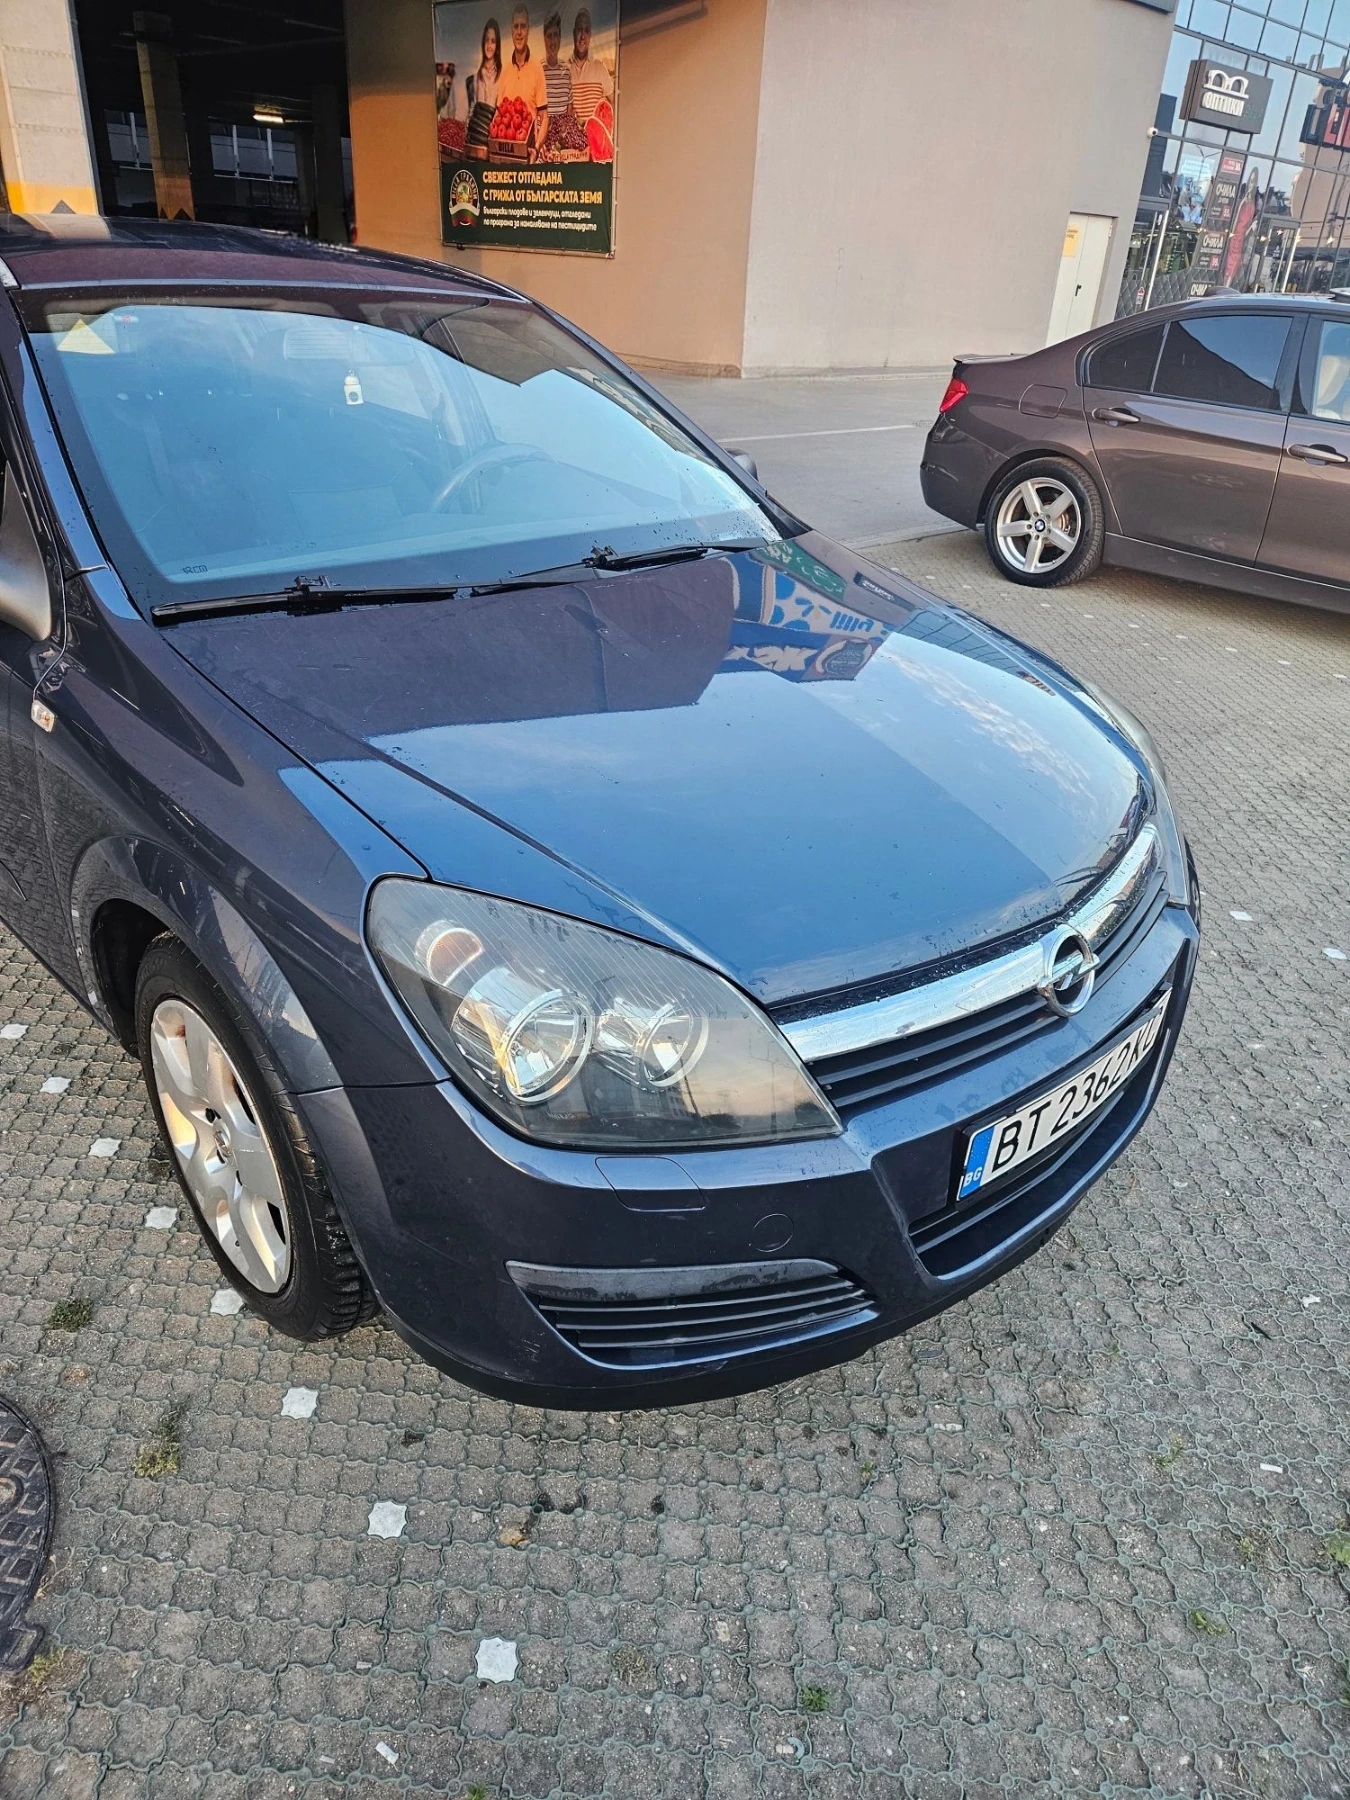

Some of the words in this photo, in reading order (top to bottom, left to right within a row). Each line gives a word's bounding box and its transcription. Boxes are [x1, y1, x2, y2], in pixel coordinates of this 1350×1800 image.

[482, 171, 517, 184] СВЕЖЕСТ
[517, 171, 563, 186] ОТГЛЕДАНА
[483, 189, 489, 201] С
[489, 189, 515, 202] ГРИЖА
[515, 190, 526, 202] ОТ
[526, 190, 579, 204] БЪЛГАРСКАТА
[579, 191, 603, 204] ЗЕМЯ
[963, 1166, 983, 1188] BG
